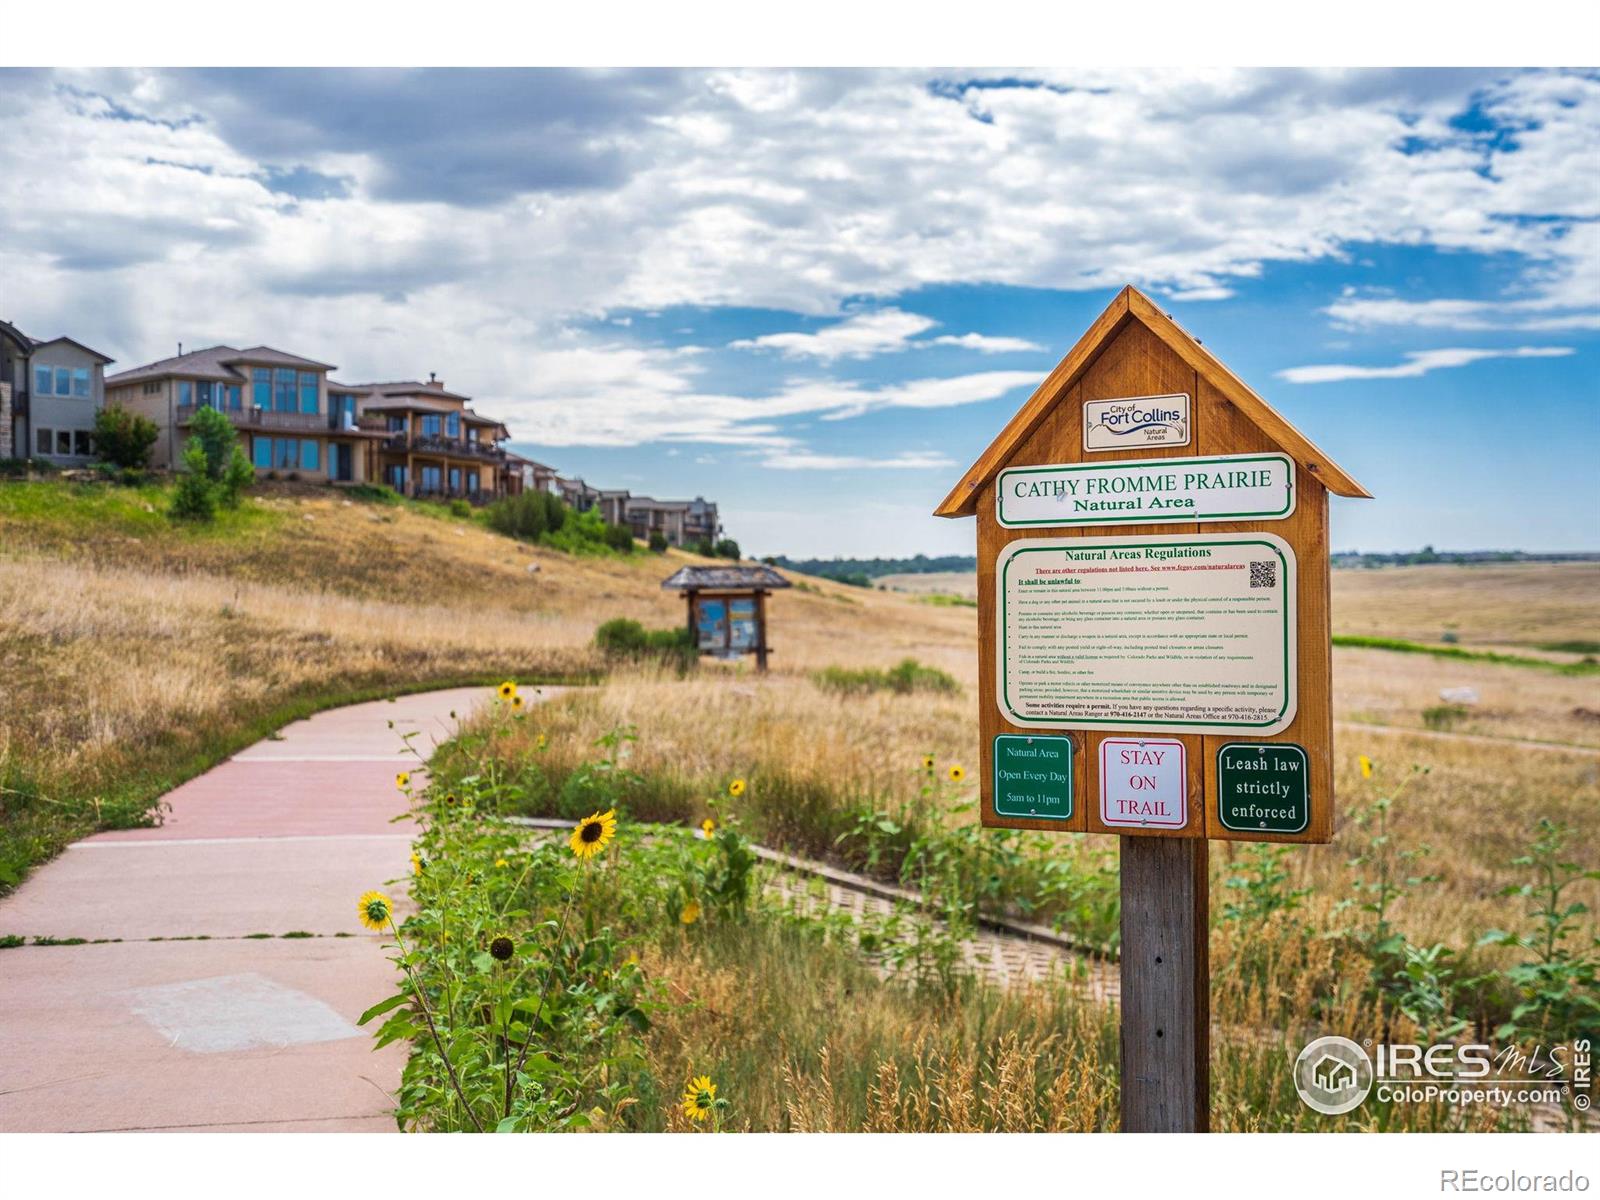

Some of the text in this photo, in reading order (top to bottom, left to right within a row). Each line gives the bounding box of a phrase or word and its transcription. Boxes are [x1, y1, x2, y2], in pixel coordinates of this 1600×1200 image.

[1110, 404, 1136, 414] City of
[1101, 408, 1180, 425] Fort Collins
[1144, 427, 1168, 436] Natural
[1015, 470, 1272, 498] CATHY FROMME PRAIRIE
[1073, 496, 1195, 512] Natural Area
[1065, 548, 1212, 561] Natural Areas Regulations
[1162, 564, 1246, 573] www.fcgov.com/naturalareas
[1007, 748, 1058, 758] Natural Area
[1120, 750, 1165, 766] STAY
[1226, 756, 1300, 772] Leash law
[999, 770, 1067, 784] Open Every Day
[1129, 776, 1156, 790] ON
[1236, 781, 1290, 798] strictly
[1006, 793, 1060, 806] 5am to 11pm
[1117, 800, 1171, 817] TRAIL
[1231, 805, 1296, 820] enforced
